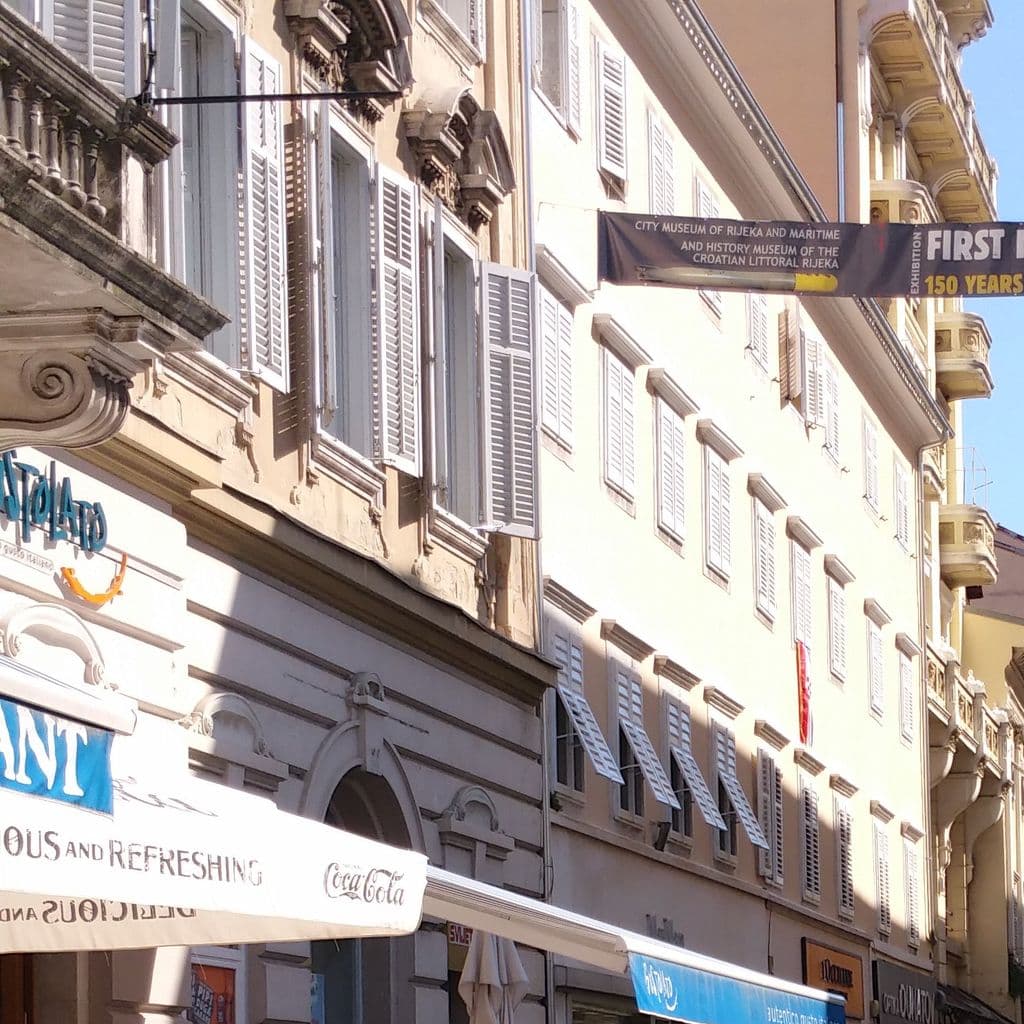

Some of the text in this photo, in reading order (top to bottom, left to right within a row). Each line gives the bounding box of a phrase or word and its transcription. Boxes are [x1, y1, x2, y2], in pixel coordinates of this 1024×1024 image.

[635, 220, 840, 240] CITY MUSEUM OF RIJEKA AND MARITIME
[681, 240, 839, 257] AND HISTORY MUSEUM OF THE
[926, 228, 1005, 262] FIRST
[693, 254, 839, 269] CROATIAN LITTORAL RIJEKA
[911, 231, 922, 294] EXHIBITION
[924, 274, 958, 295] 150
[963, 272, 1024, 294] YEARS
[66, 841, 103, 862] AND
[108, 839, 262, 886] REFRESHING
